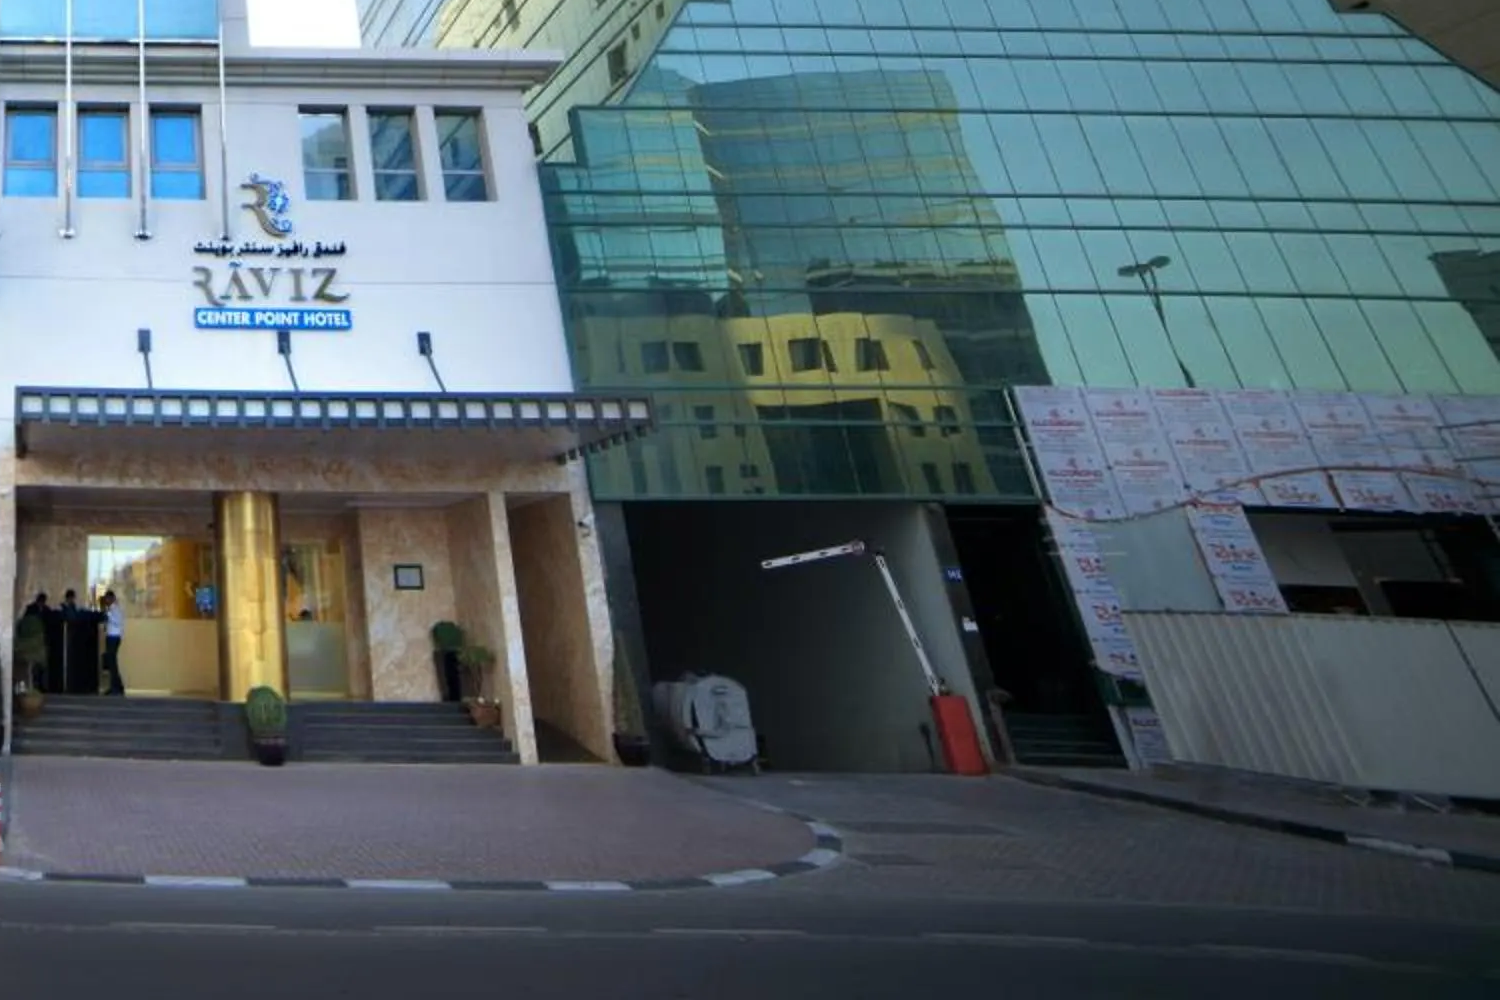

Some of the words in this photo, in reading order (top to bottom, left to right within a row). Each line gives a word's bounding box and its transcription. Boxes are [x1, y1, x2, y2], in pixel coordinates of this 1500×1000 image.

[237, 242, 274, 256] سنتر
[313, 241, 347, 258] فندق
[197, 311, 250, 325] CENTER
[256, 311, 300, 325] POINT
[304, 312, 349, 326] HOTEL
